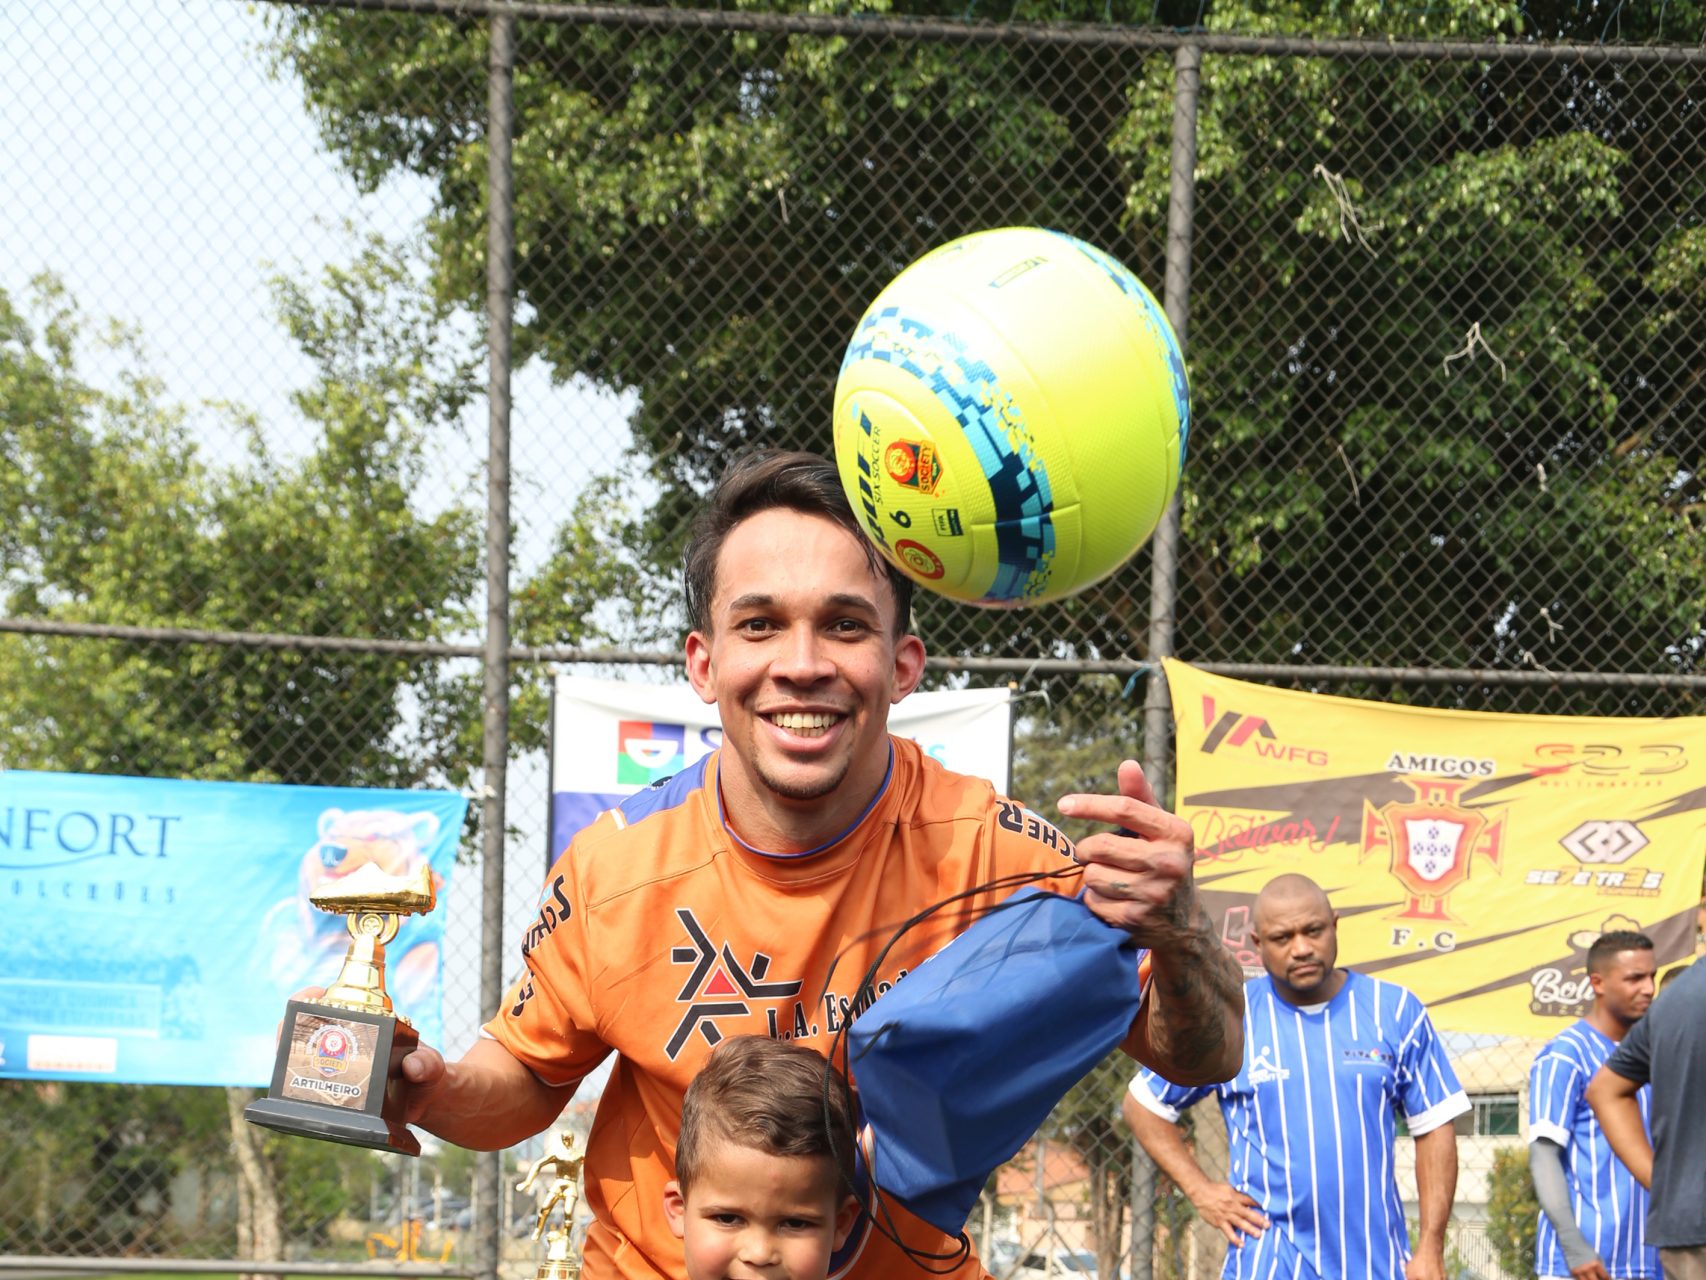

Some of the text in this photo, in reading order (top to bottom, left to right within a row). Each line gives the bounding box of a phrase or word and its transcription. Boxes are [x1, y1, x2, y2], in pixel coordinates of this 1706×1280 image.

[871, 426, 884, 505] SIX SOCCER
[920, 445, 932, 492] SOCIETY
[889, 510, 912, 529] 6
[1255, 740, 1329, 767] WFG
[1388, 754, 1494, 777] AMIGOS
[291, 1077, 361, 1097] ARTILHEIRO
